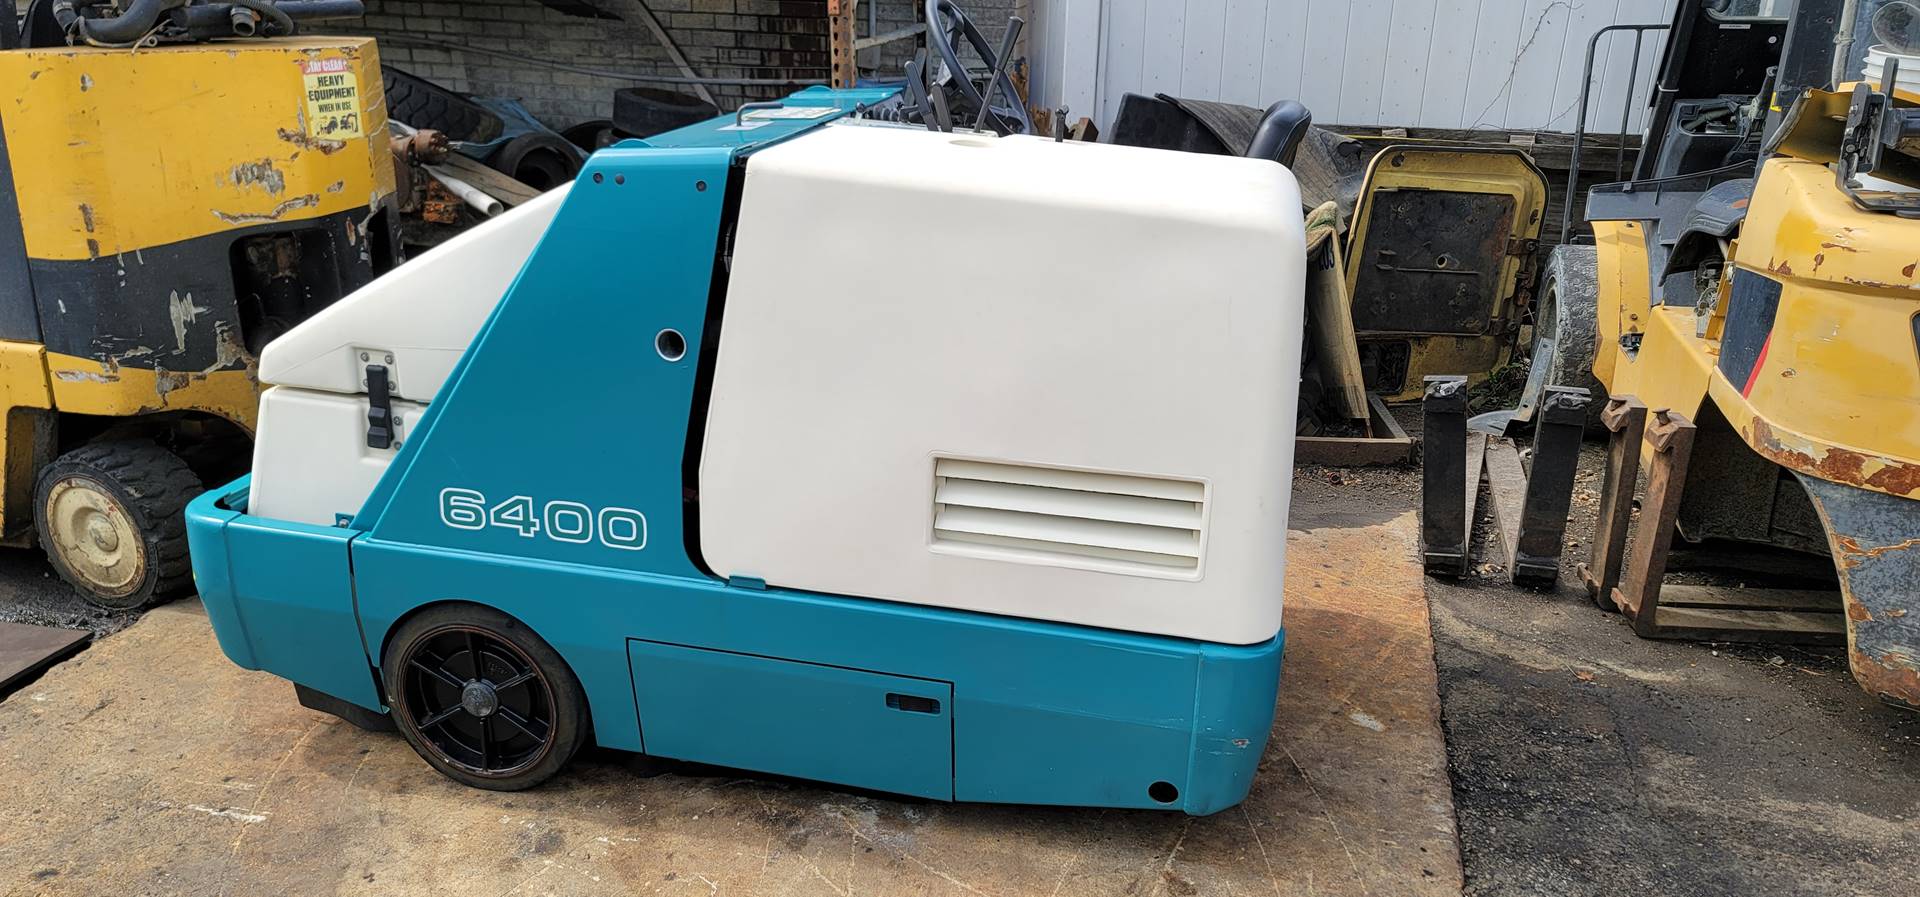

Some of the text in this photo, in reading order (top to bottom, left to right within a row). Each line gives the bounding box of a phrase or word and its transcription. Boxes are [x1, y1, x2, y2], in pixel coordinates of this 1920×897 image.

[317, 75, 344, 87] HEAVY
[308, 87, 355, 101] EQUIPMENT
[318, 101, 352, 113] WHEN IN USE
[439, 487, 647, 550] 6400
